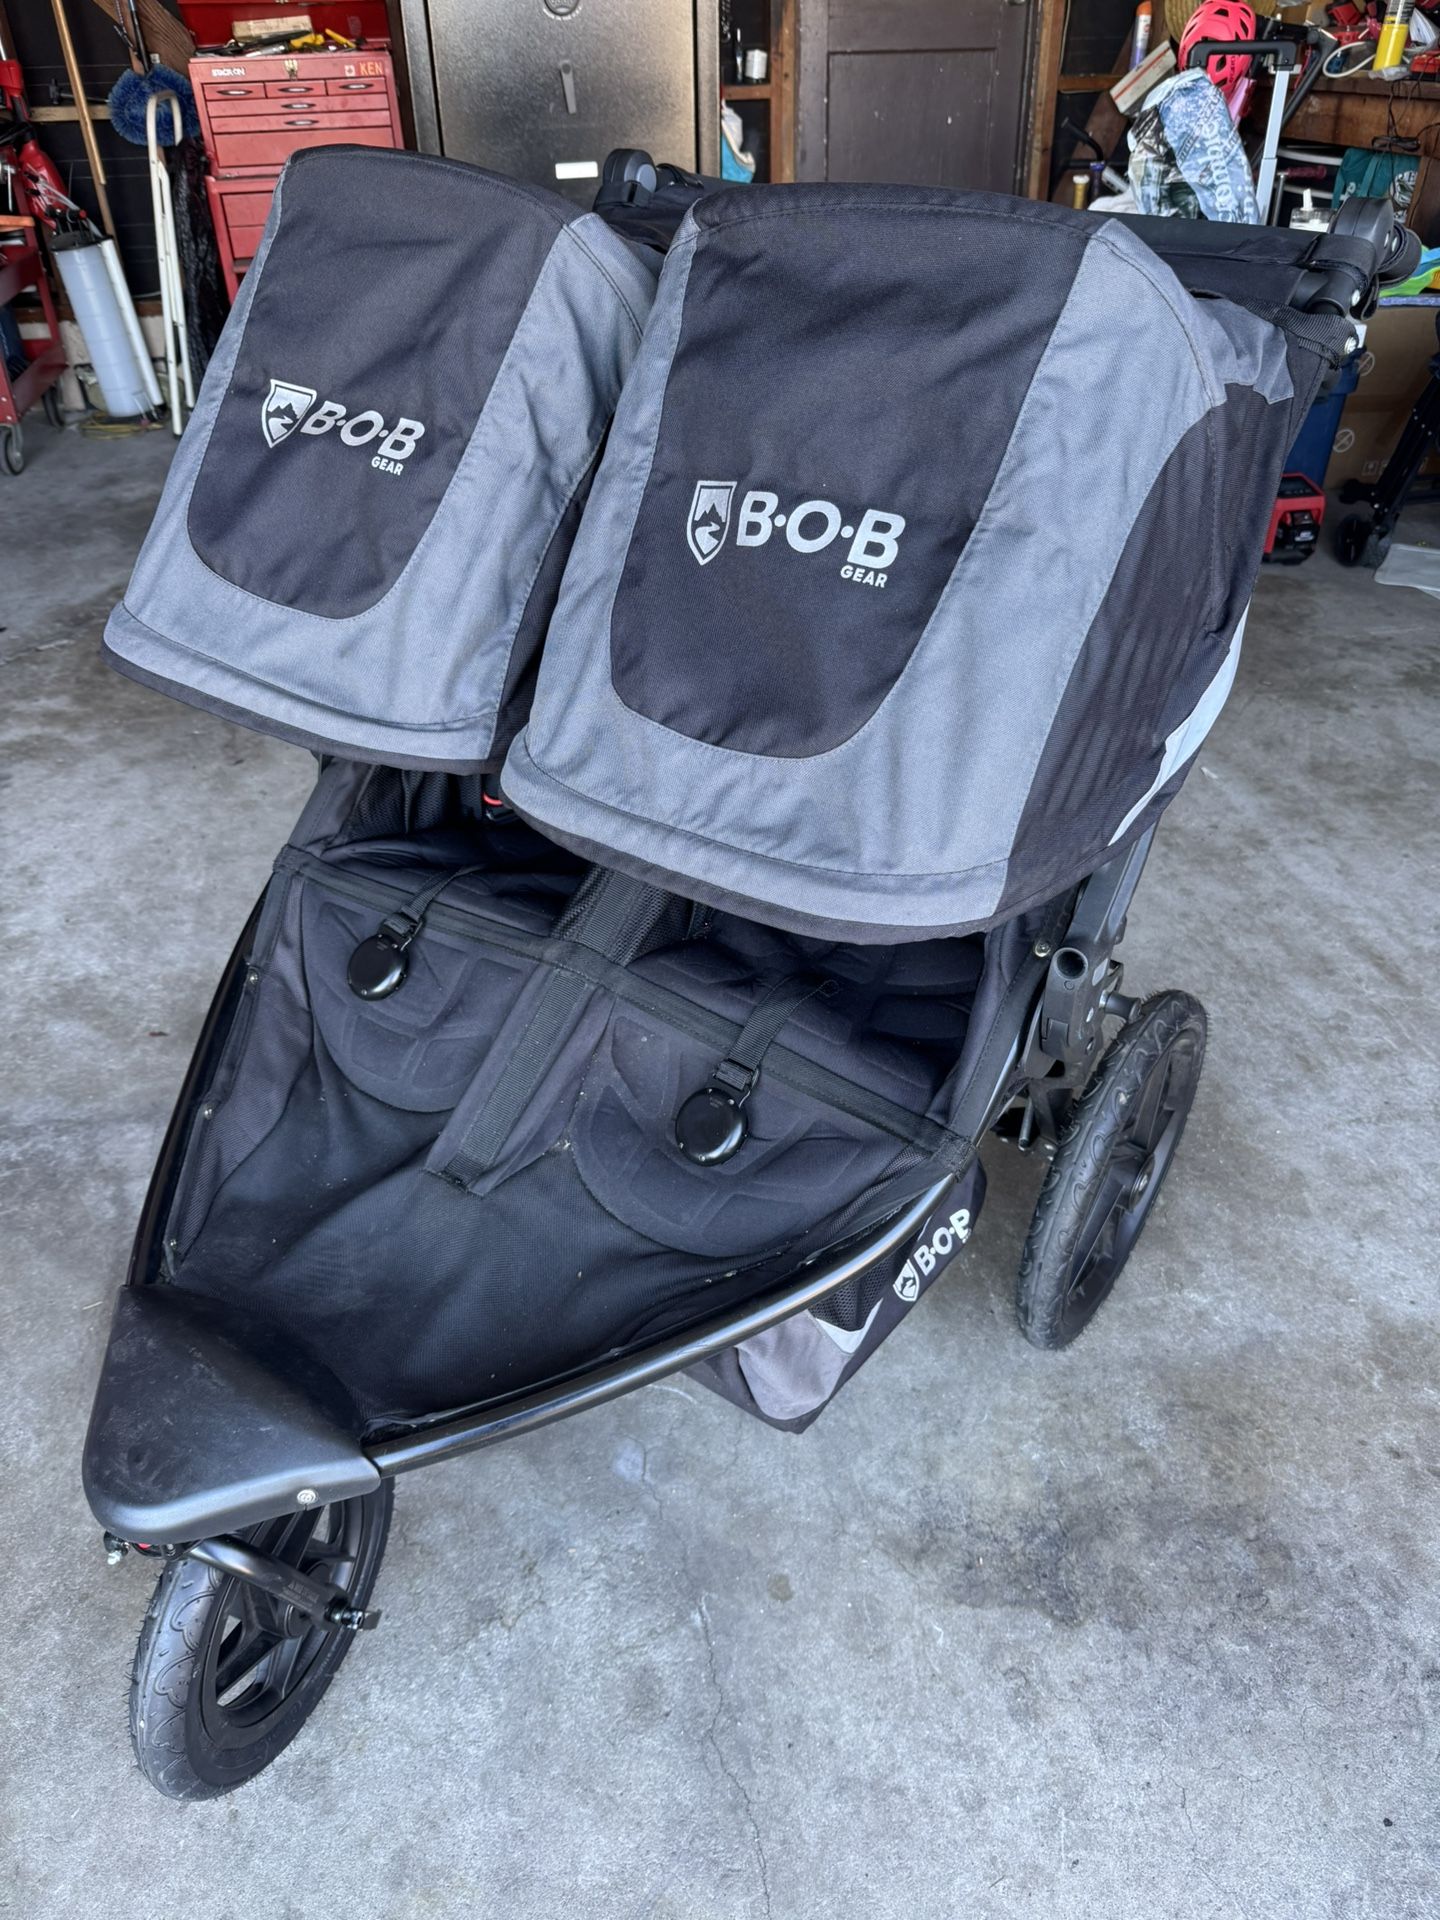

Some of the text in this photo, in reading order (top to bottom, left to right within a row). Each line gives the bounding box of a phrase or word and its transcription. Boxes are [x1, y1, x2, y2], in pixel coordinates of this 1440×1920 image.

[360, 61, 384, 77] KEN
[371, 456, 404, 476] GEAR
[840, 565, 889, 588] GEAR
